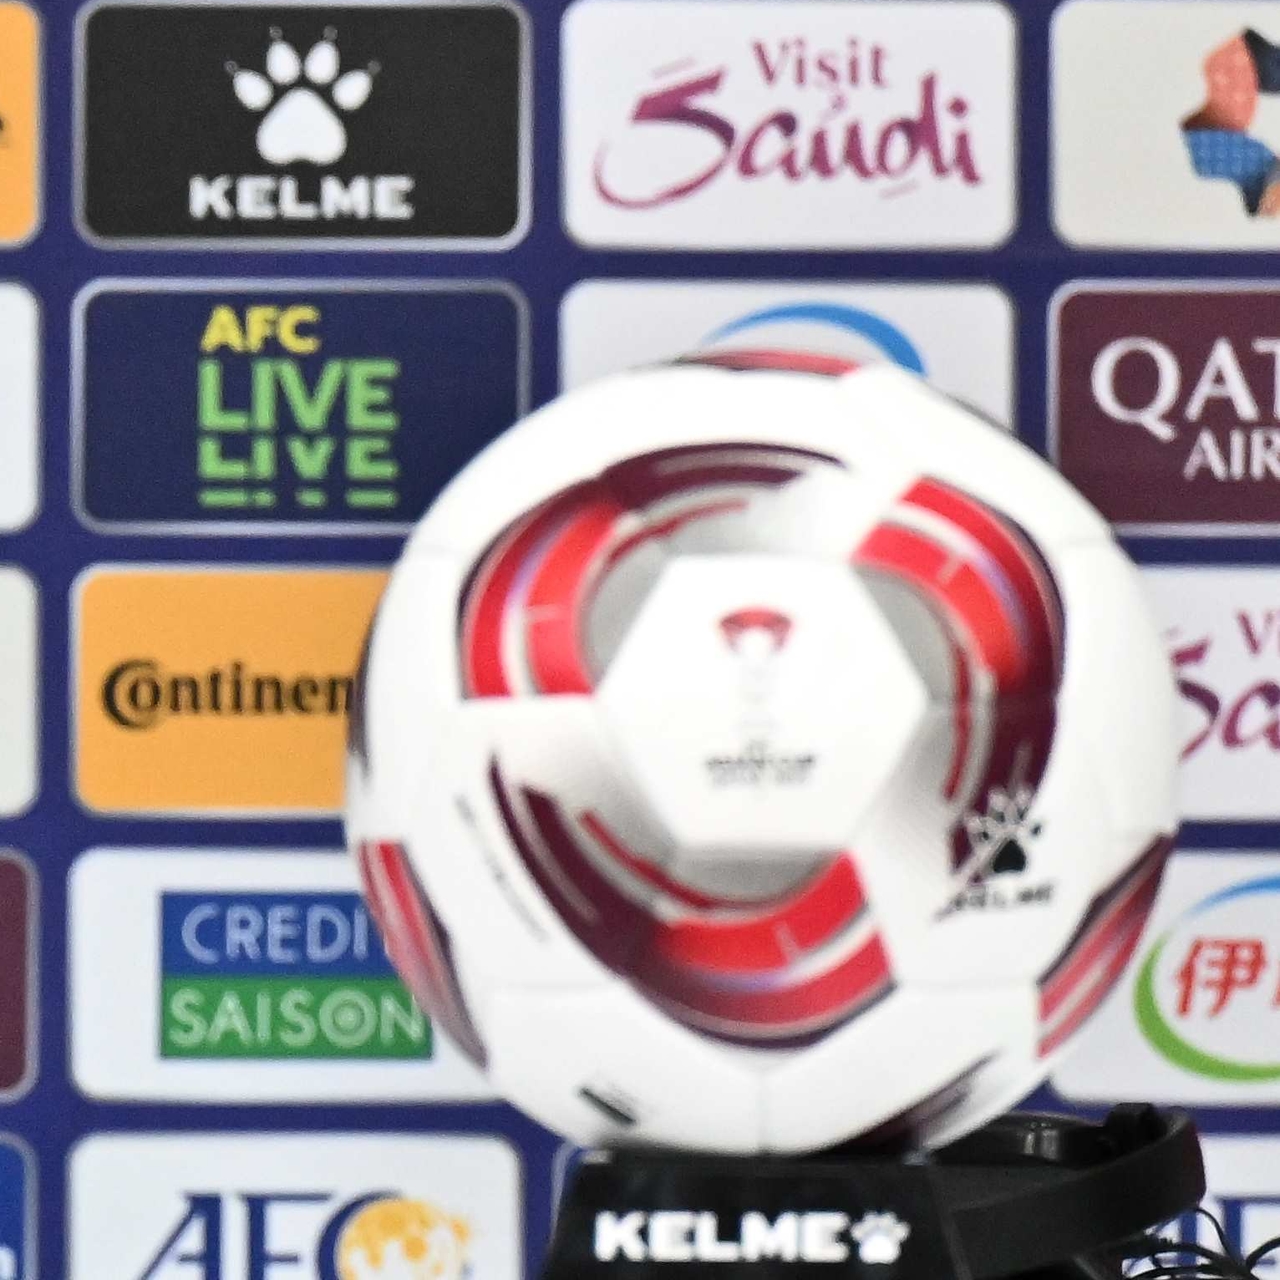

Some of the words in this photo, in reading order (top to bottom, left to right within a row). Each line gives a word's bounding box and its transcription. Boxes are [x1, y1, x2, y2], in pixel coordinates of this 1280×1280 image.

[753, 40, 885, 87] Visit
[594, 72, 981, 210] Saudi
[190, 176, 413, 219] KELME
[202, 306, 318, 354] AFC
[199, 360, 397, 430] LIVE
[181, 903, 369, 964] CREDI
[169, 988, 426, 1048] SAISON
[594, 1211, 848, 1262] KELME
